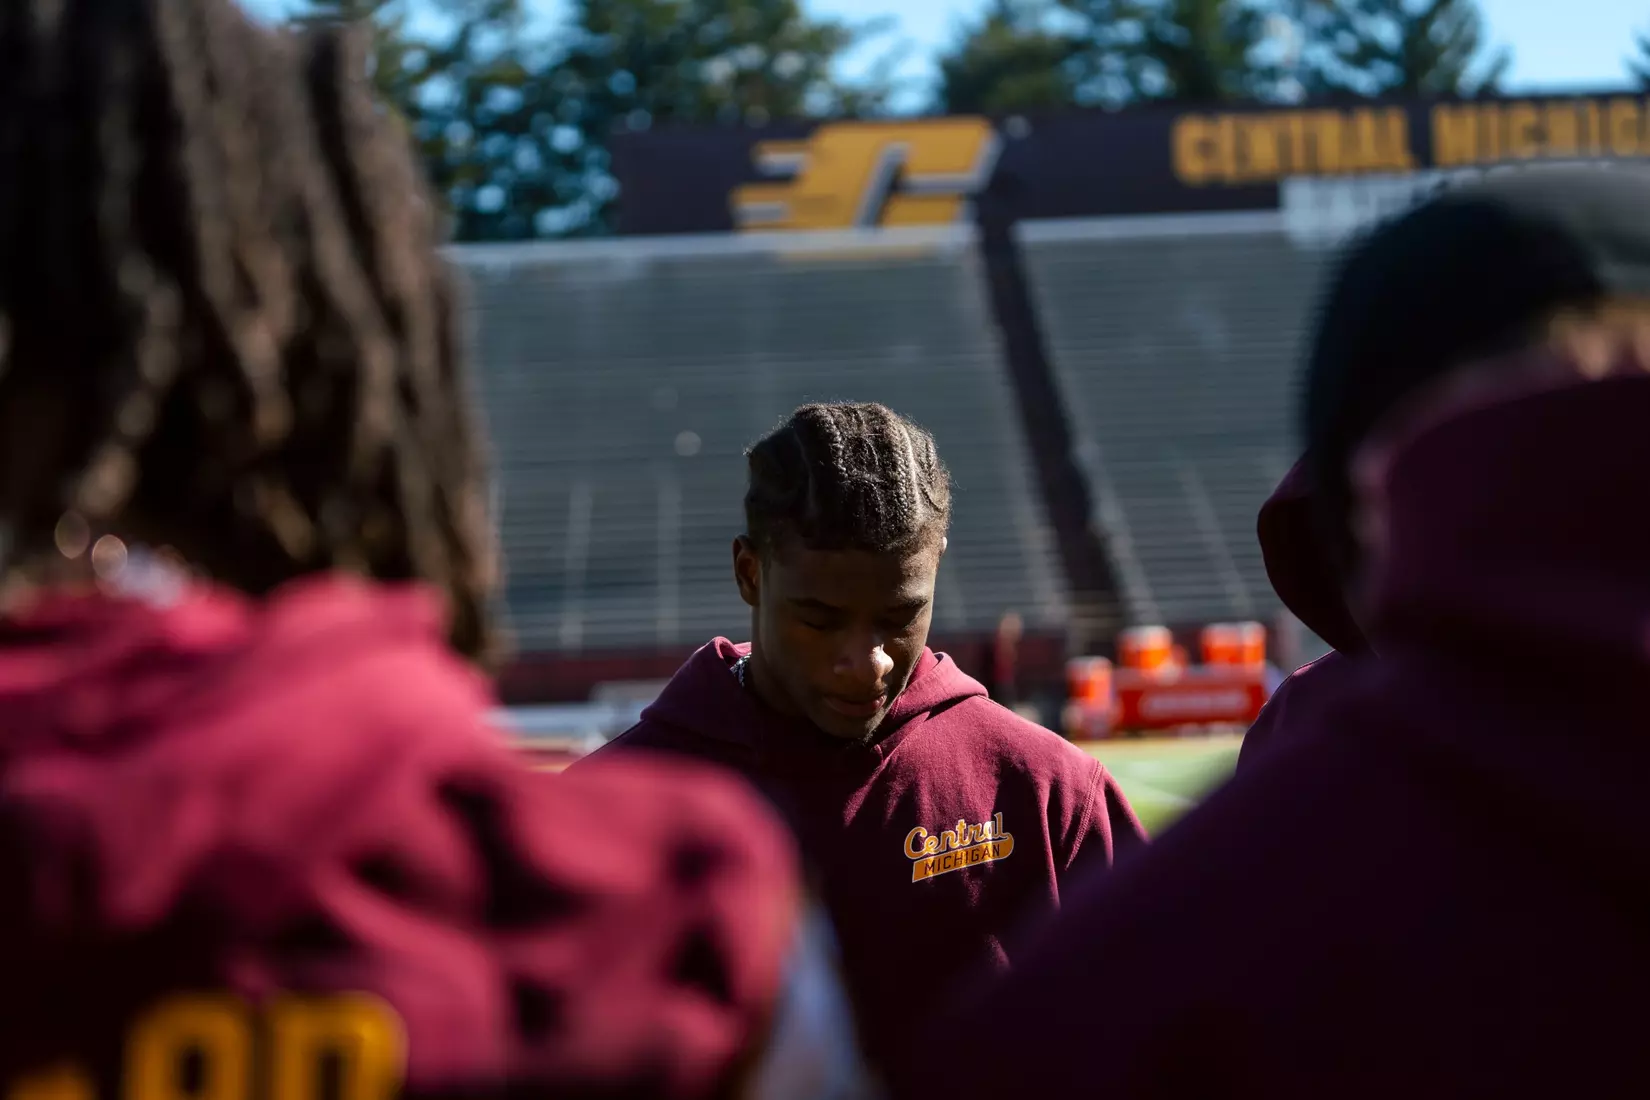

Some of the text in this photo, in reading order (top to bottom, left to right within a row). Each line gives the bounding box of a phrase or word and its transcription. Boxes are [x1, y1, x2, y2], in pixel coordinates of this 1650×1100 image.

[1172, 107, 1416, 186] CENTRAL
[904, 812, 1009, 860] Central
[924, 843, 1001, 875] MICHIGAN
